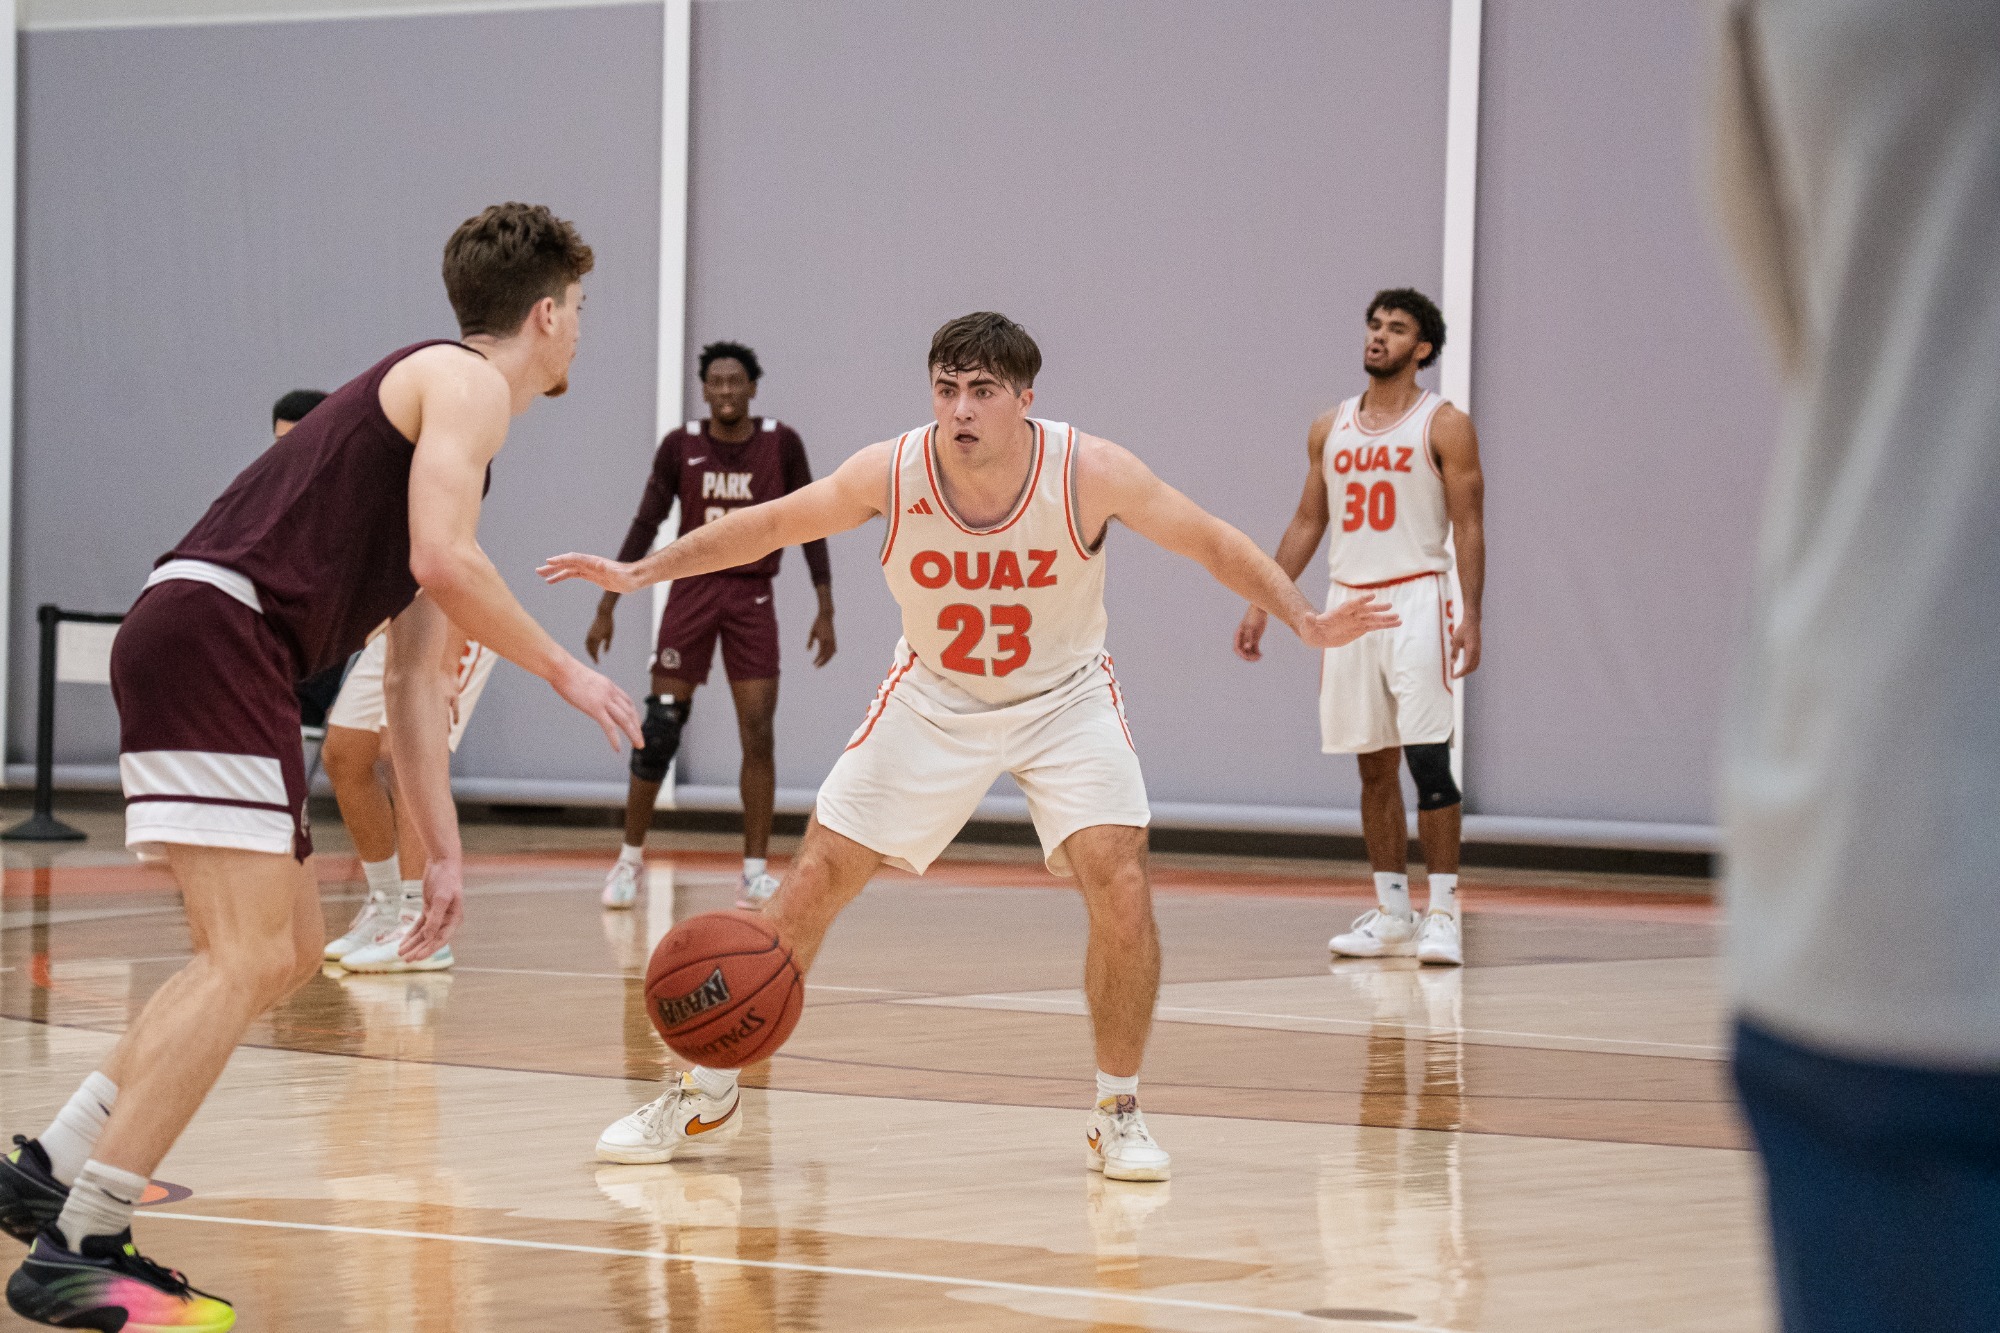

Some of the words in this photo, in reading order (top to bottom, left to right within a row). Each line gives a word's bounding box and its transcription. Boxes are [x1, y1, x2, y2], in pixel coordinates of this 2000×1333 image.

[1334, 445, 1414, 475] OUAZ
[702, 471, 754, 500] PARK
[1342, 480, 1396, 532] 30
[910, 549, 1058, 591] OUAZ
[937, 602, 1032, 678] 23
